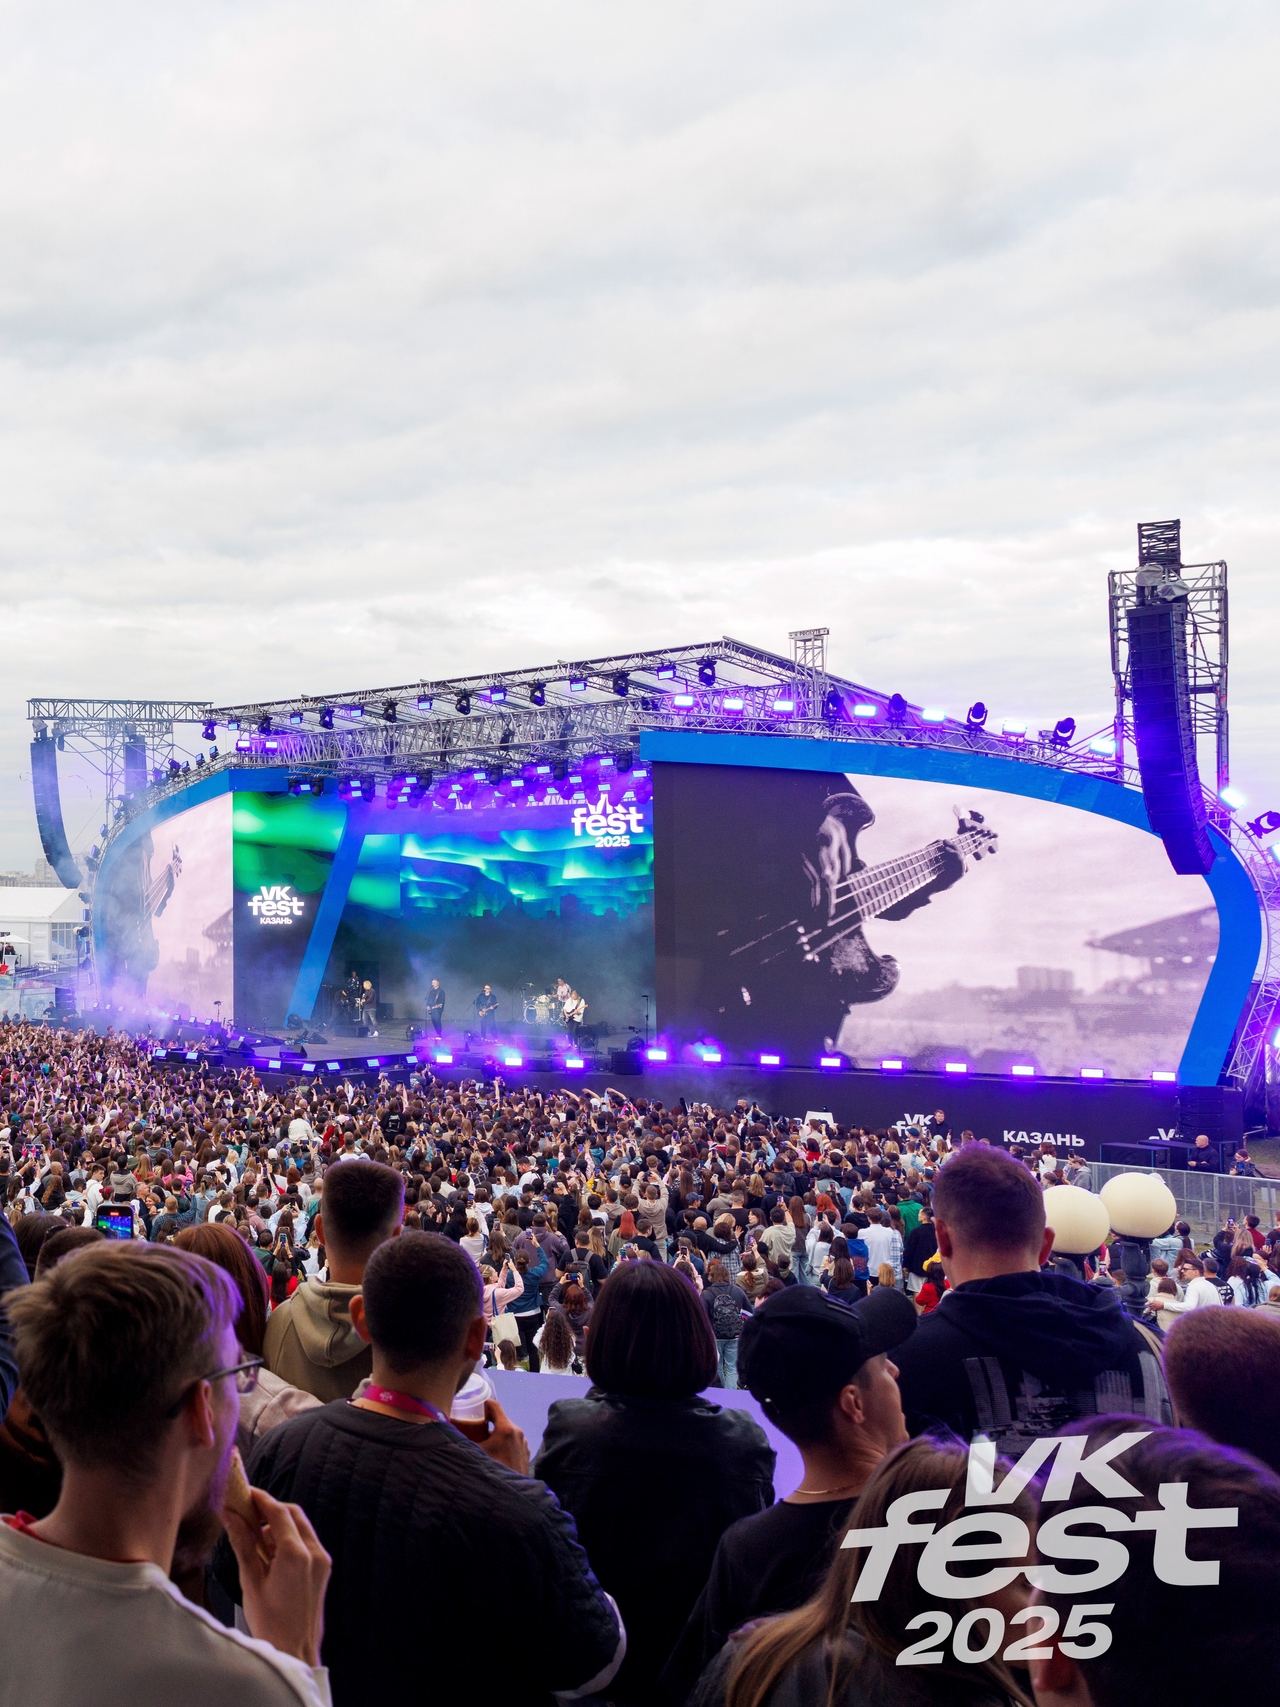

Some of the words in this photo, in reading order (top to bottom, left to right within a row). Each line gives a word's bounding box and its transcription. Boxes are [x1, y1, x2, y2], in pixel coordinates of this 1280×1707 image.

[571, 806, 644, 836] fest
[595, 835, 630, 848] 2025
[260, 886, 291, 900] VK
[247, 895, 304, 916] fest
[260, 917, 292, 925] КАЗАНЬ
[904, 1113, 934, 1126] VK
[1003, 1130, 1085, 1147] КАЗАНЬ
